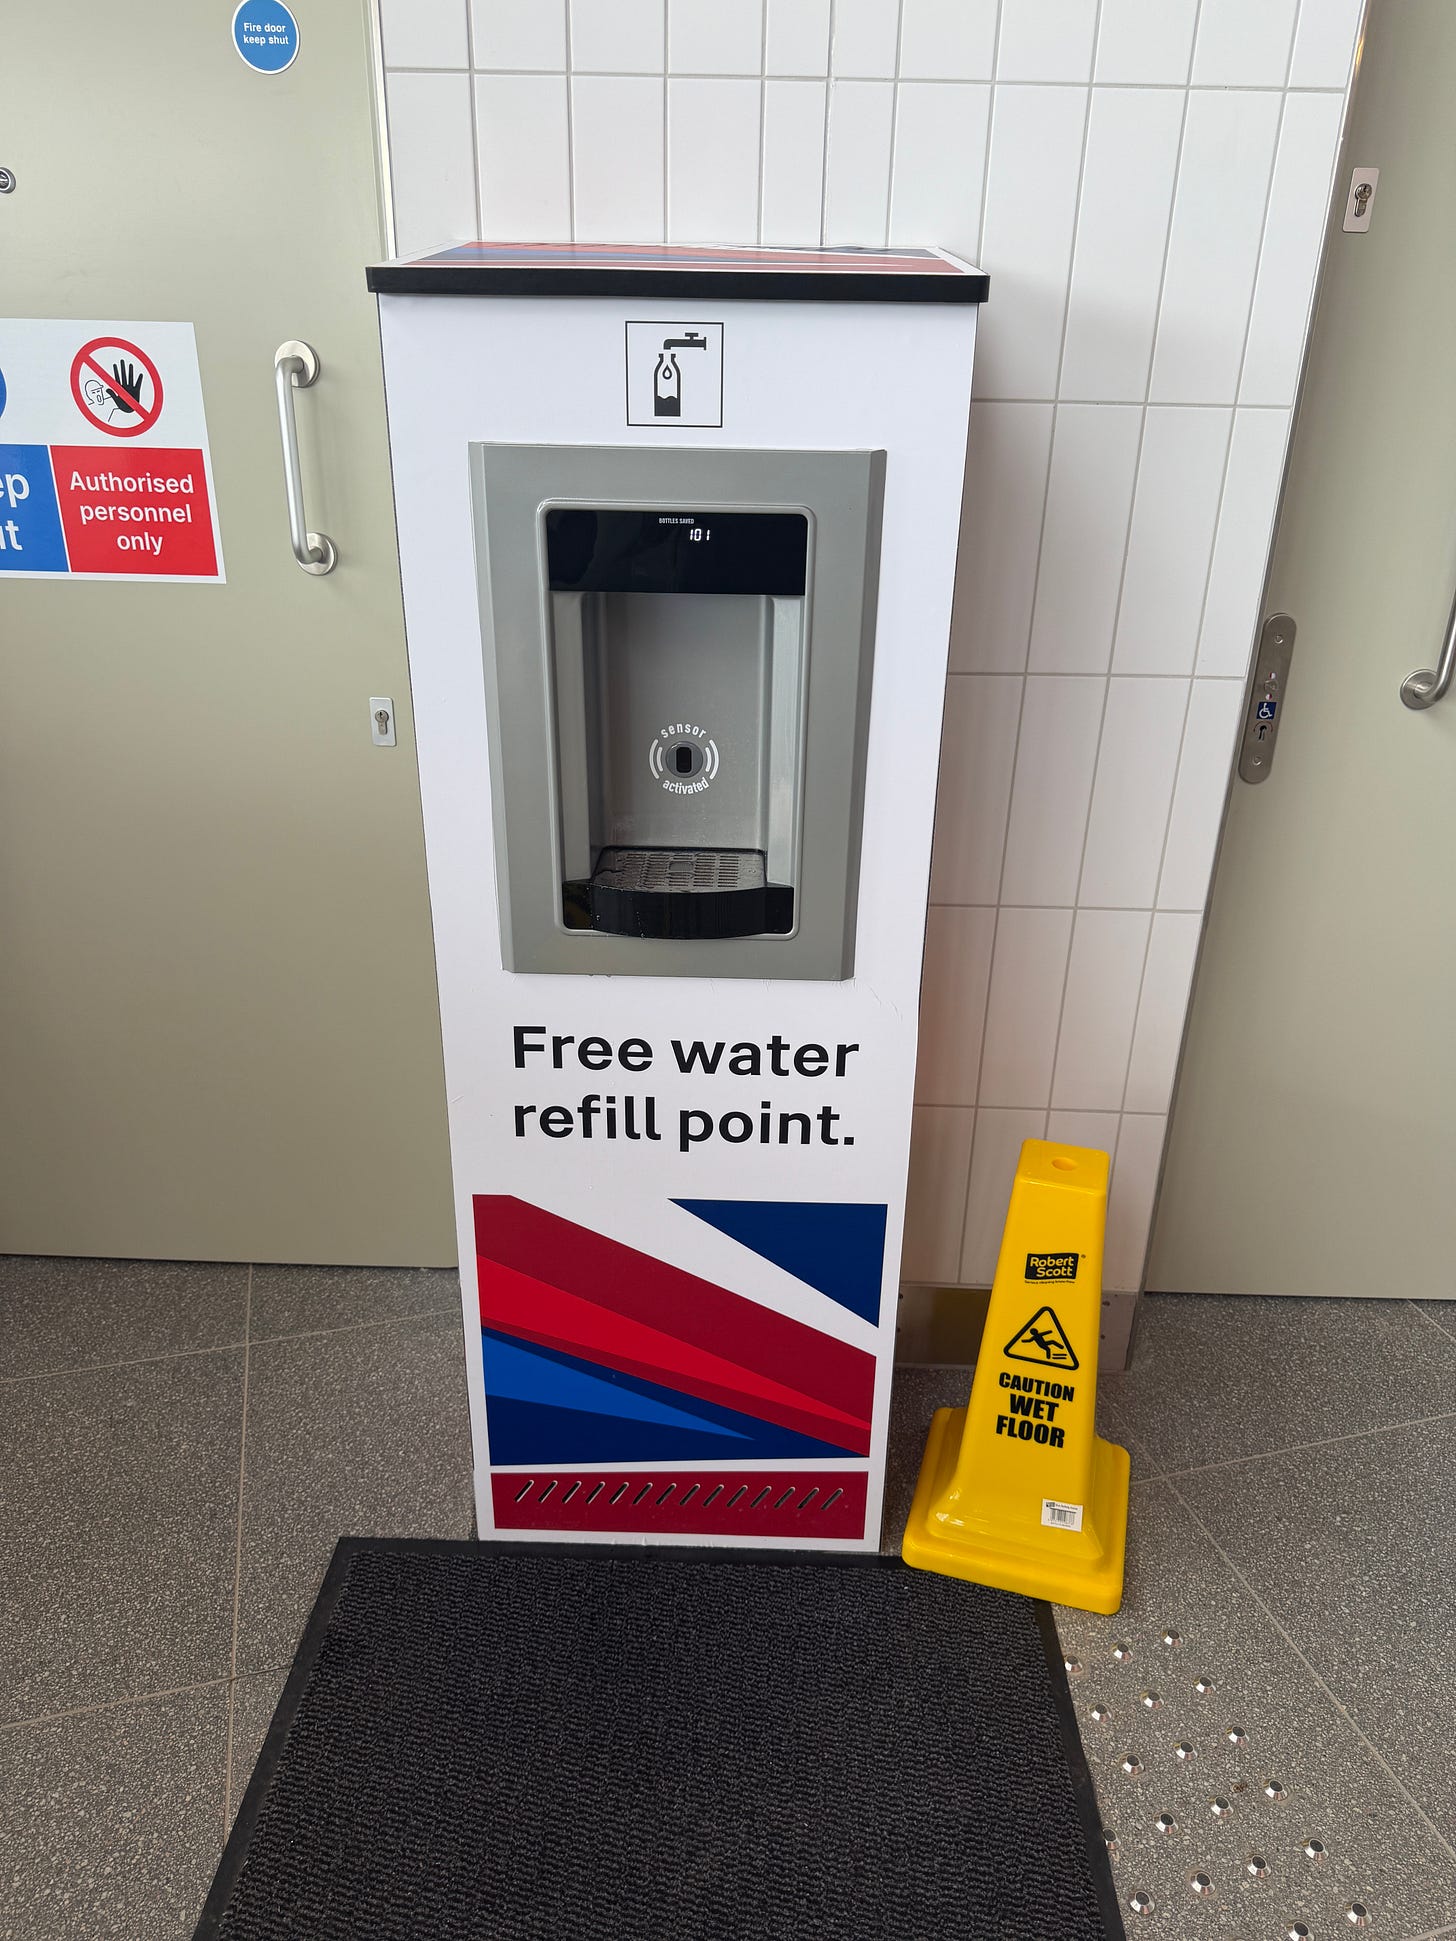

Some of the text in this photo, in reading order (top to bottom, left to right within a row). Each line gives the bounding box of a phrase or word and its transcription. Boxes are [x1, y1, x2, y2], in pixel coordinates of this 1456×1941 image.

[243, 22, 286, 33] Fire door
[243, 34, 289, 46] keep shut
[70, 471, 194, 494] Authorised
[80, 504, 193, 525] personnel
[117, 532, 163, 556] only
[689, 528, 710, 541] 101
[661, 723, 707, 738] sensor
[662, 777, 710, 795] activated
[513, 1025, 860, 1077] Free water
[514, 1094, 856, 1153] refill point.
[1029, 1256, 1075, 1268] Robert
[1036, 1266, 1073, 1278] Scott
[998, 1372, 1075, 1403] CAUTION
[1009, 1393, 1060, 1422] WET
[995, 1414, 1066, 1449] FLOOR
